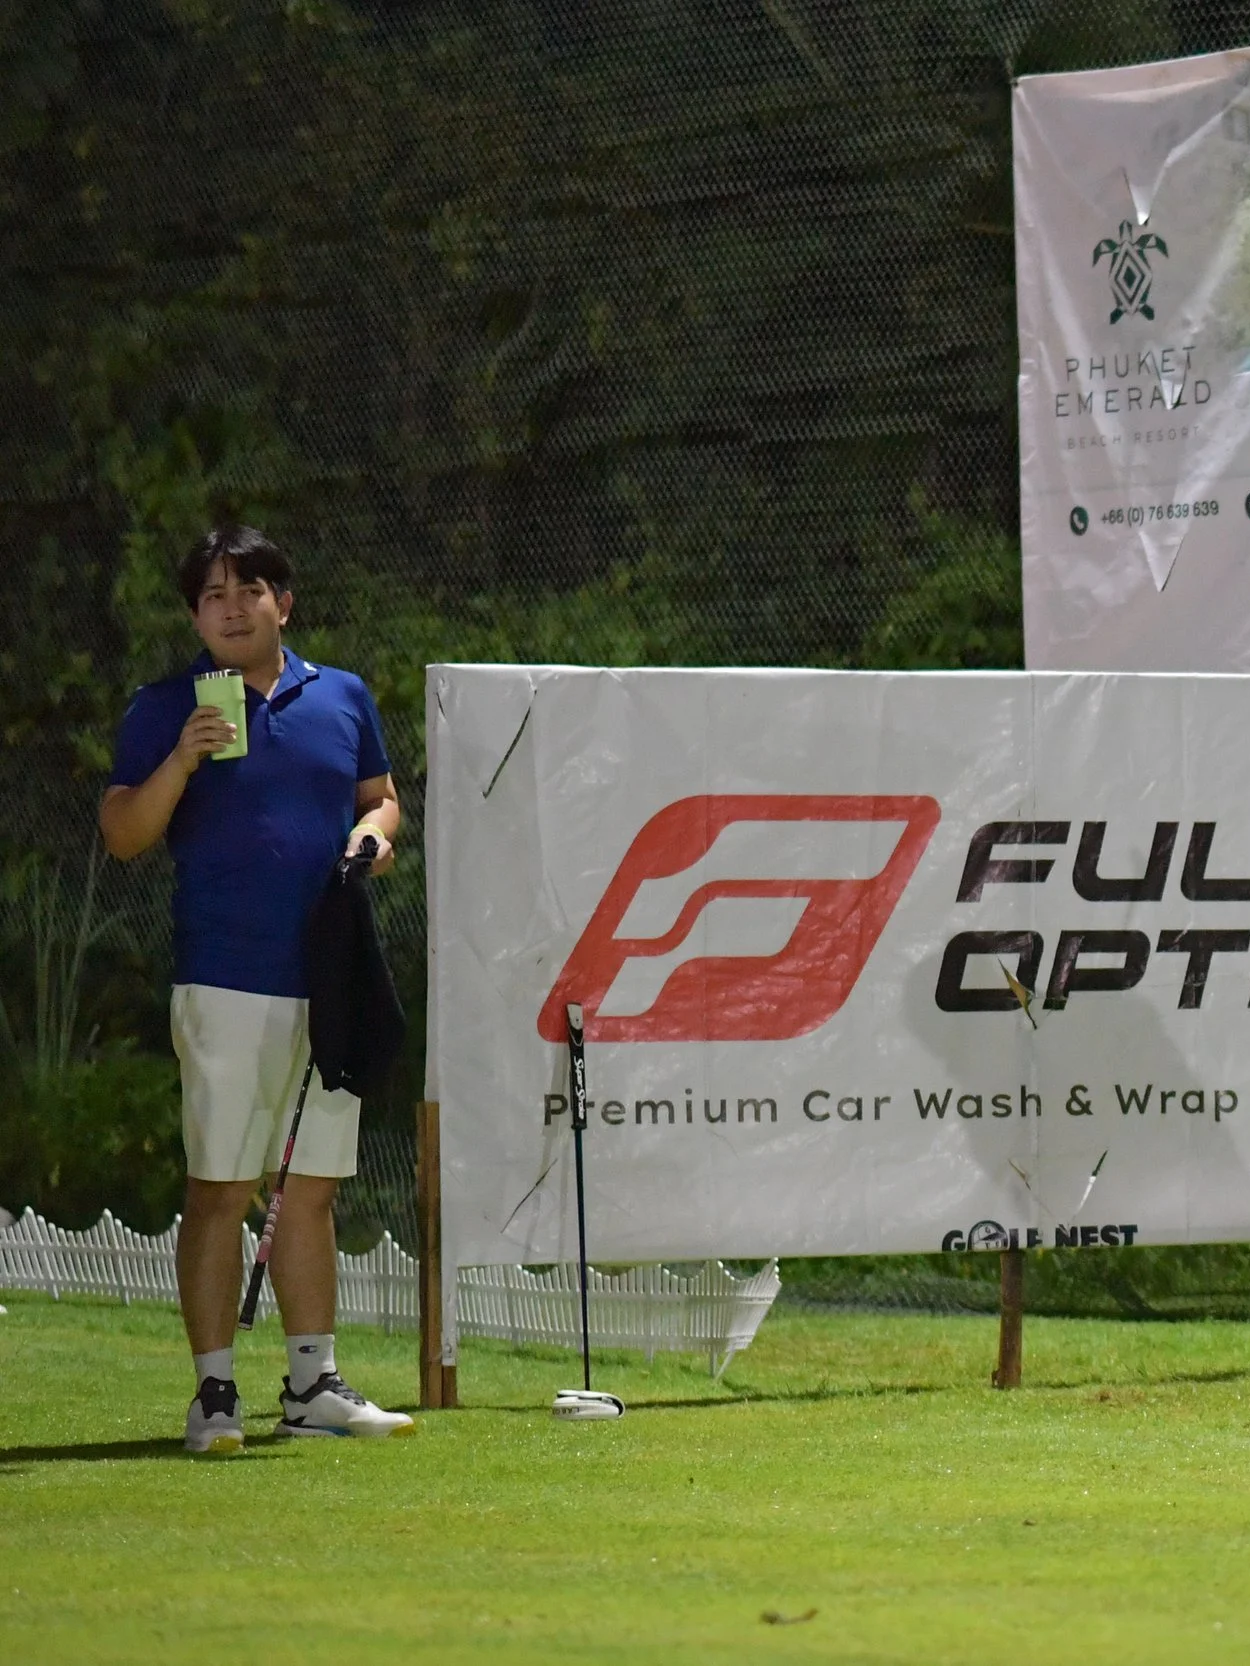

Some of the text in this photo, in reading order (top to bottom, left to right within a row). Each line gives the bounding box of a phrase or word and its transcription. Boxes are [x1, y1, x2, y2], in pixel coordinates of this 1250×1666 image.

[1065, 346, 1197, 382] PHUKET
[1134, 426, 1200, 444] RESORT
[1101, 500, 1219, 527] +66 (0) 76 639 639
[802, 1089, 892, 1122] Car
[912, 1084, 1042, 1120] Wash
[1064, 1084, 1094, 1116] &
[1114, 1083, 1239, 1122] Wrap
